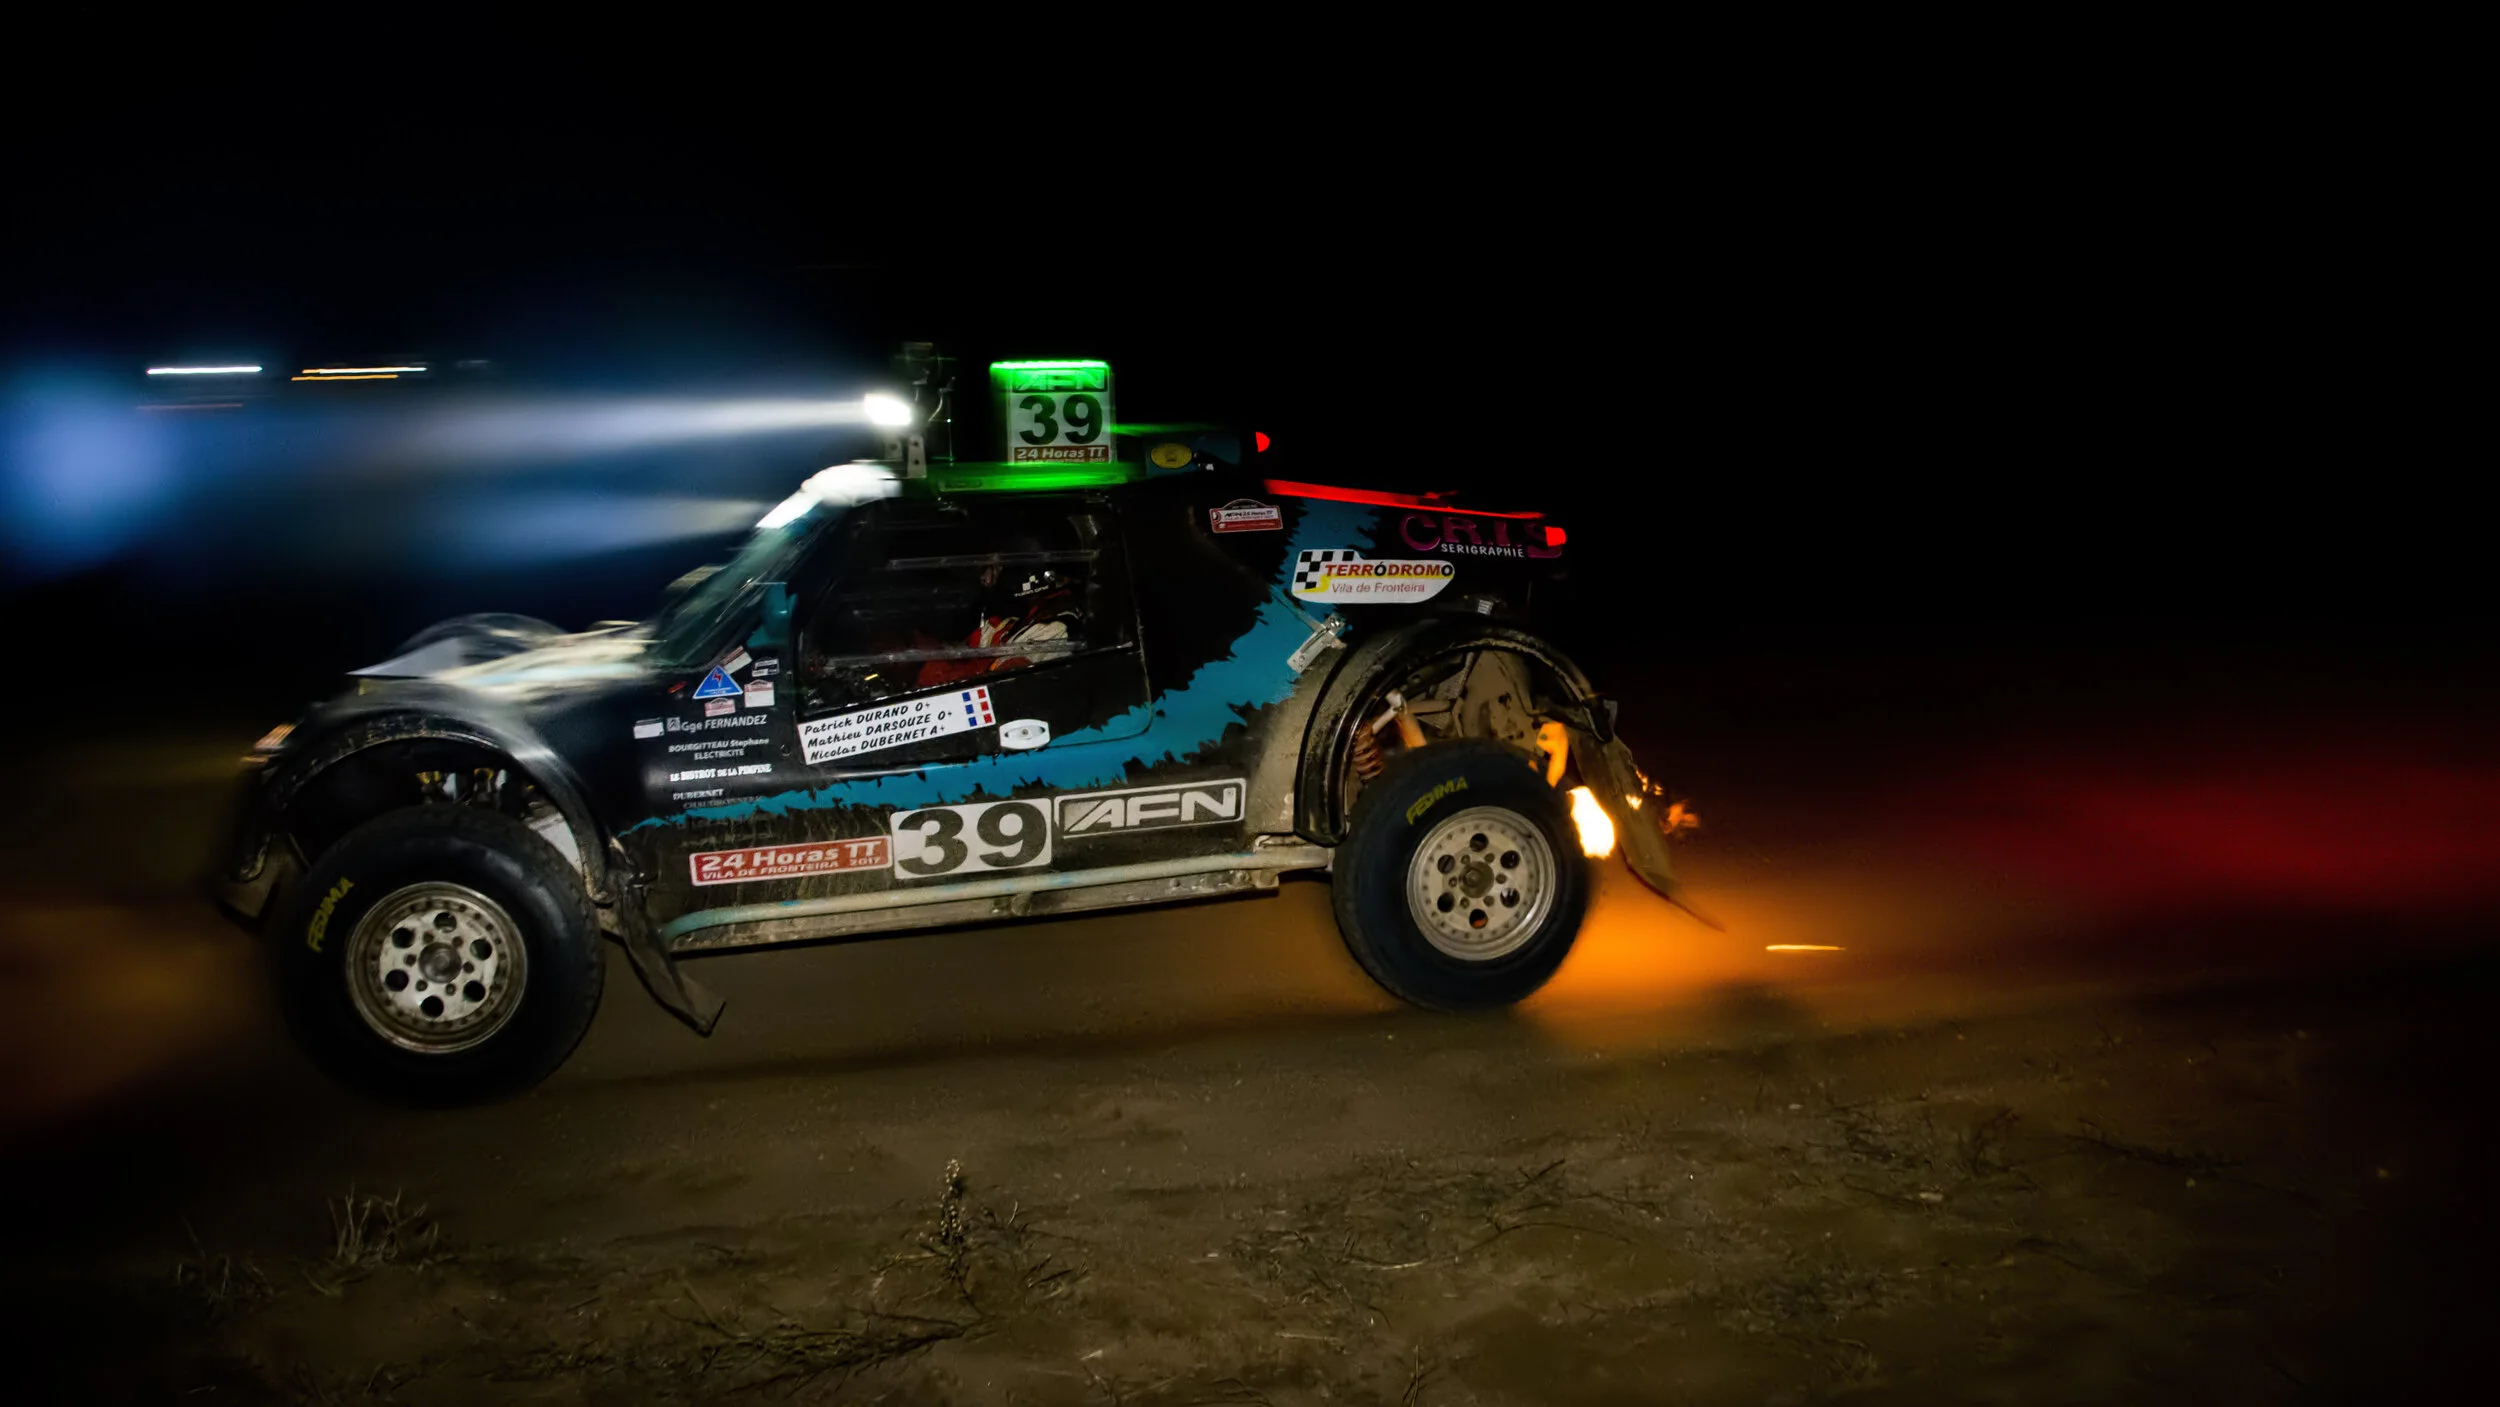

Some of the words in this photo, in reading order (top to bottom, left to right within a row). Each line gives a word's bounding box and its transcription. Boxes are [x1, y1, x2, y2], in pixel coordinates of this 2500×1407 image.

[1019, 394, 1102, 445] 39
[1017, 448, 1039, 459] 24
[1042, 447, 1085, 459] Horas
[1088, 446, 1106, 458] TT
[1325, 562, 1453, 577] TERRÓDROMO
[1332, 582, 1353, 593] Vila
[1356, 581, 1371, 593] de
[1374, 581, 1425, 593] Fronteira
[705, 714, 768, 730] FERNANDEZ
[804, 718, 853, 735] Patrick
[856, 705, 909, 725] DURAND
[807, 731, 861, 748] Mathieu
[866, 713, 931, 735] DARSOUZE
[810, 746, 856, 761] Nicolas
[861, 728, 926, 750] DUBERNET
[1063, 787, 1237, 833] AFN
[1405, 776, 1468, 827] FEDIMA
[897, 802, 1046, 875] 39
[701, 853, 746, 872] 24
[752, 848, 839, 867] Horas
[844, 841, 882, 858] TT
[702, 871, 734, 880] VILA
[737, 868, 757, 878] DE
[760, 861, 839, 875] FRONTEIRA
[849, 857, 882, 867] 2017
[306, 876, 355, 954] FEDIMA
